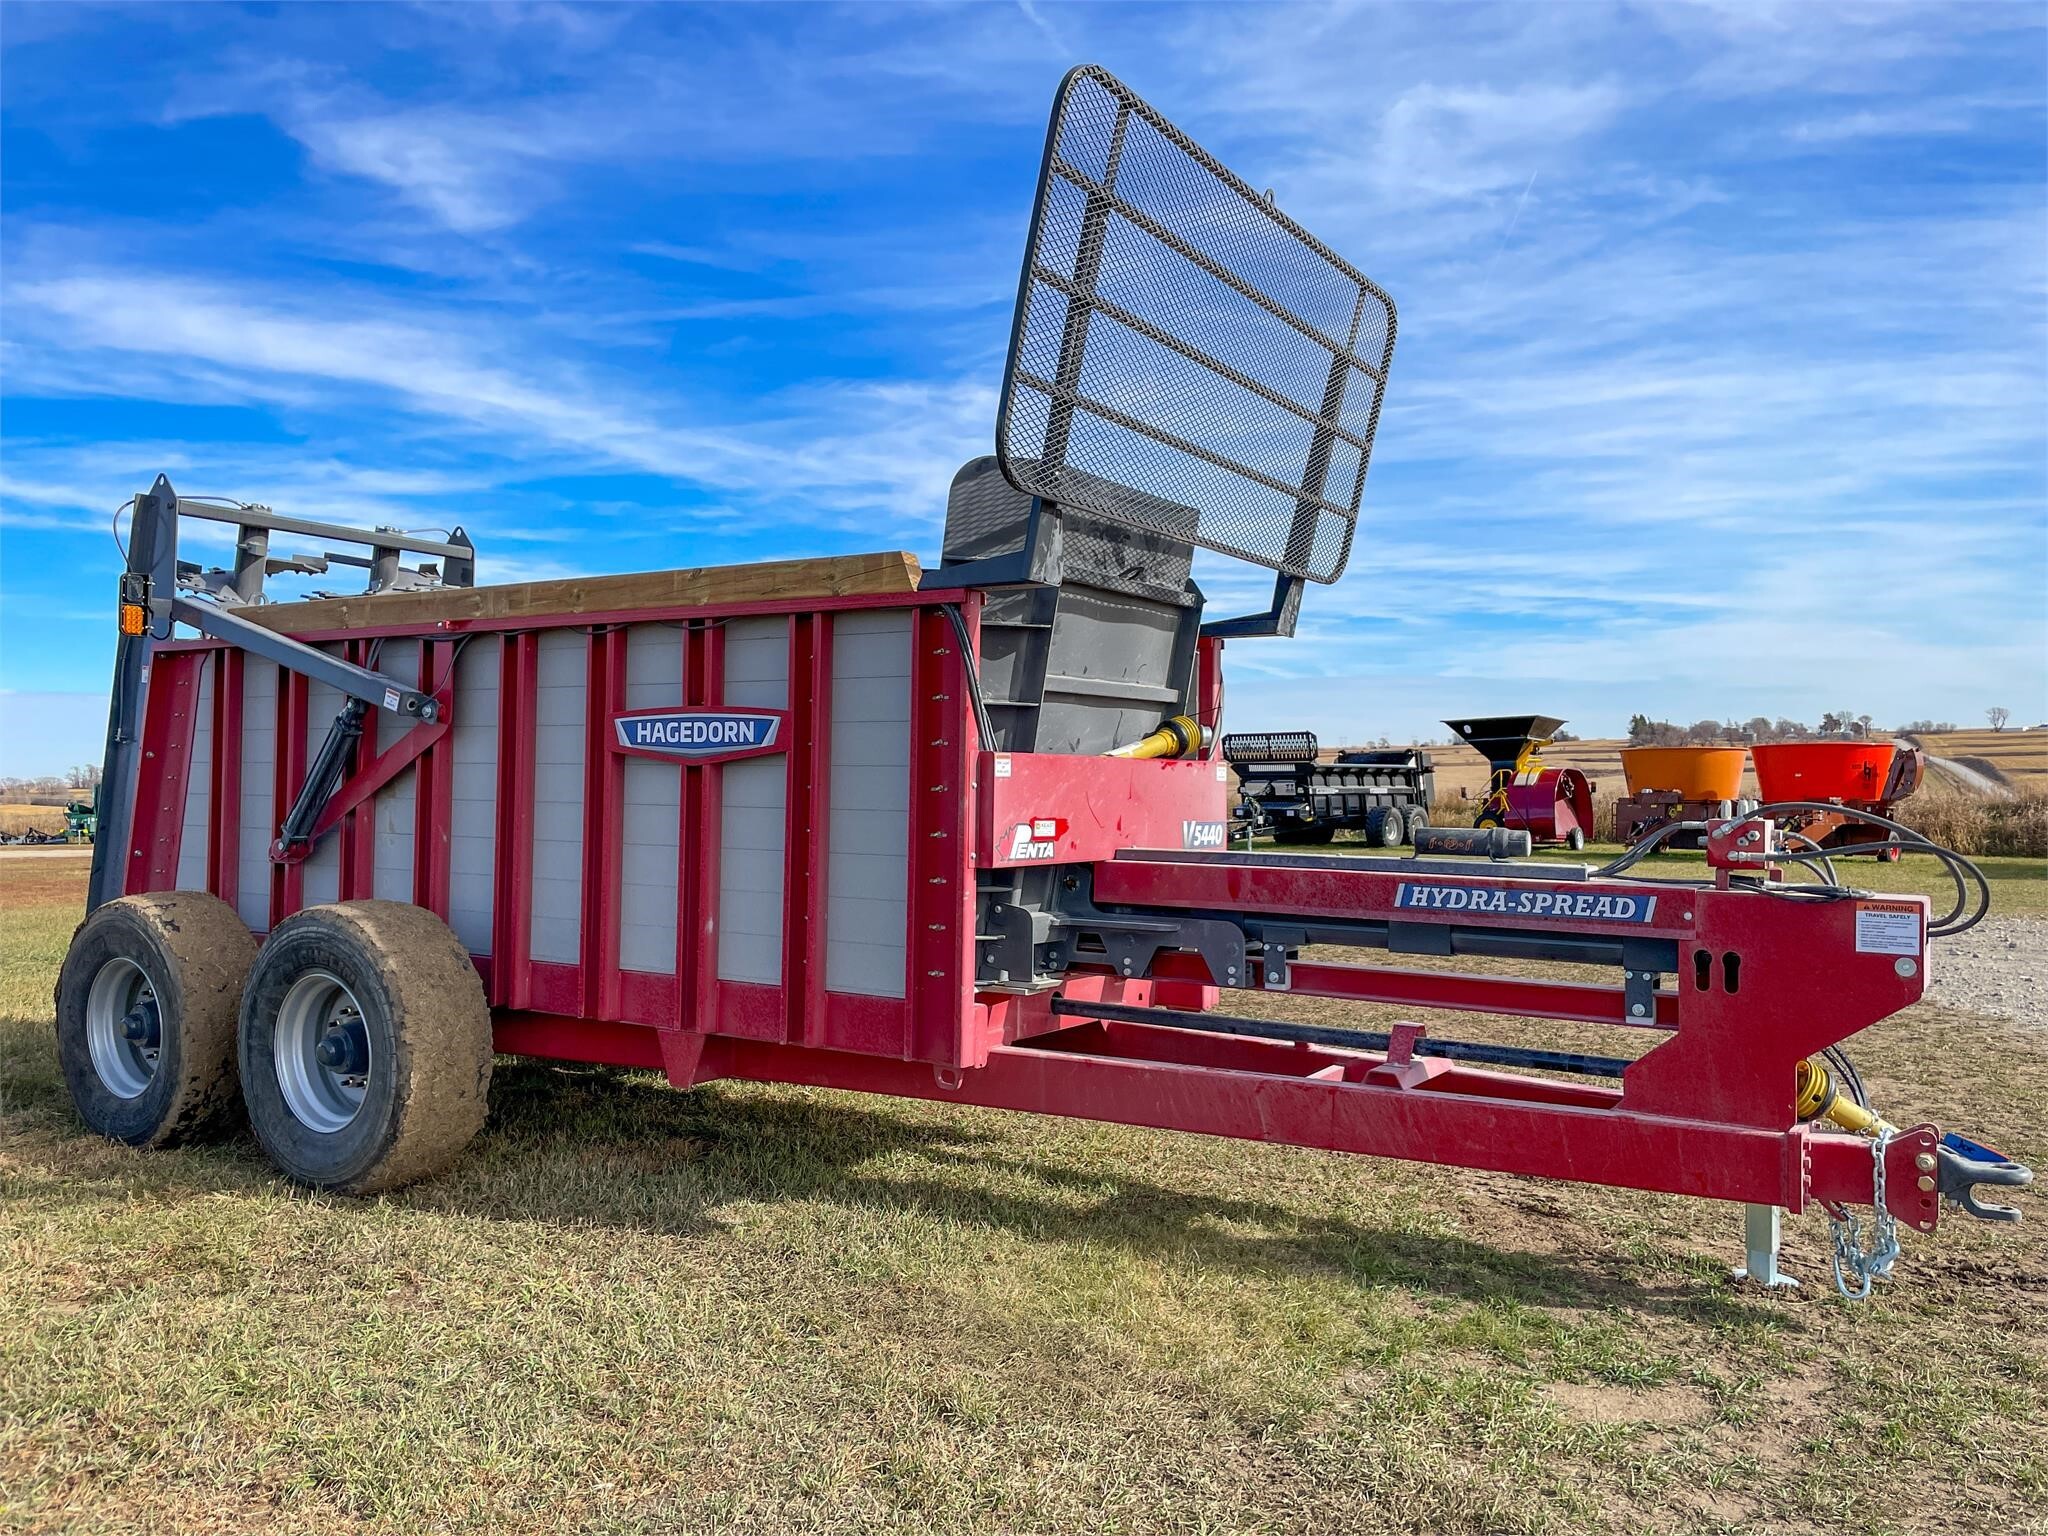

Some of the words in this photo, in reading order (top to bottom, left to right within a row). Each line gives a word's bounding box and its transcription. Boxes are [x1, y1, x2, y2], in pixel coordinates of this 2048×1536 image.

[636, 721, 755, 743] HAGEDORN
[1009, 824, 1054, 859] PENTA
[1182, 820, 1223, 849] V5440
[1409, 886, 1636, 918] HYDRA-SPREAD
[1871, 904, 1914, 912] WARNING
